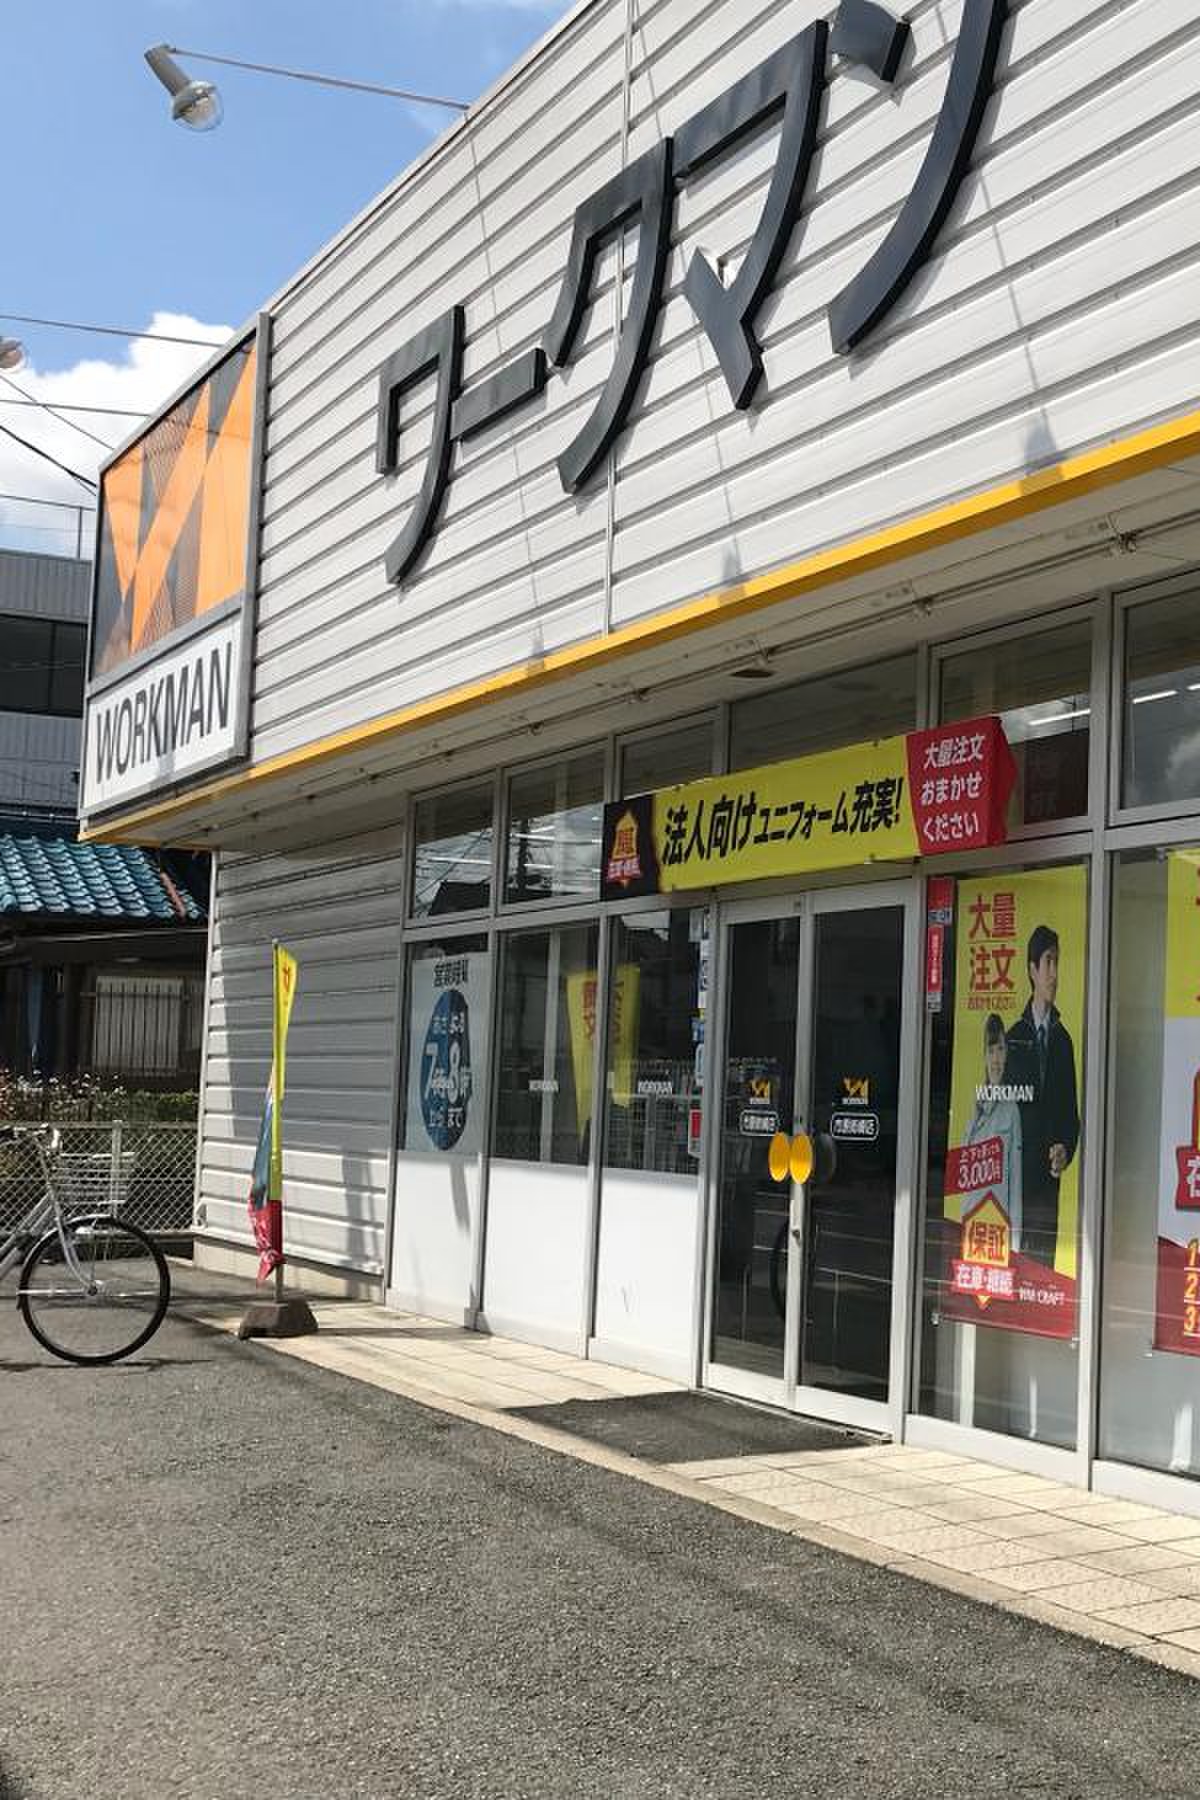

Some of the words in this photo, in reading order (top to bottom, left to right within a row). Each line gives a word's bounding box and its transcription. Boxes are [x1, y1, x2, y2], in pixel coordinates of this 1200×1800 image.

[376, 0, 1004, 587] ワークマン
[95, 642, 232, 784] WORKMAN
[923, 733, 985, 769] 大量注文
[921, 771, 982, 806] おまかせ
[923, 812, 979, 841] ください
[968, 892, 1016, 939] 大量
[969, 944, 1016, 993] 注文
[975, 1083, 1034, 1102] WORKMAN
